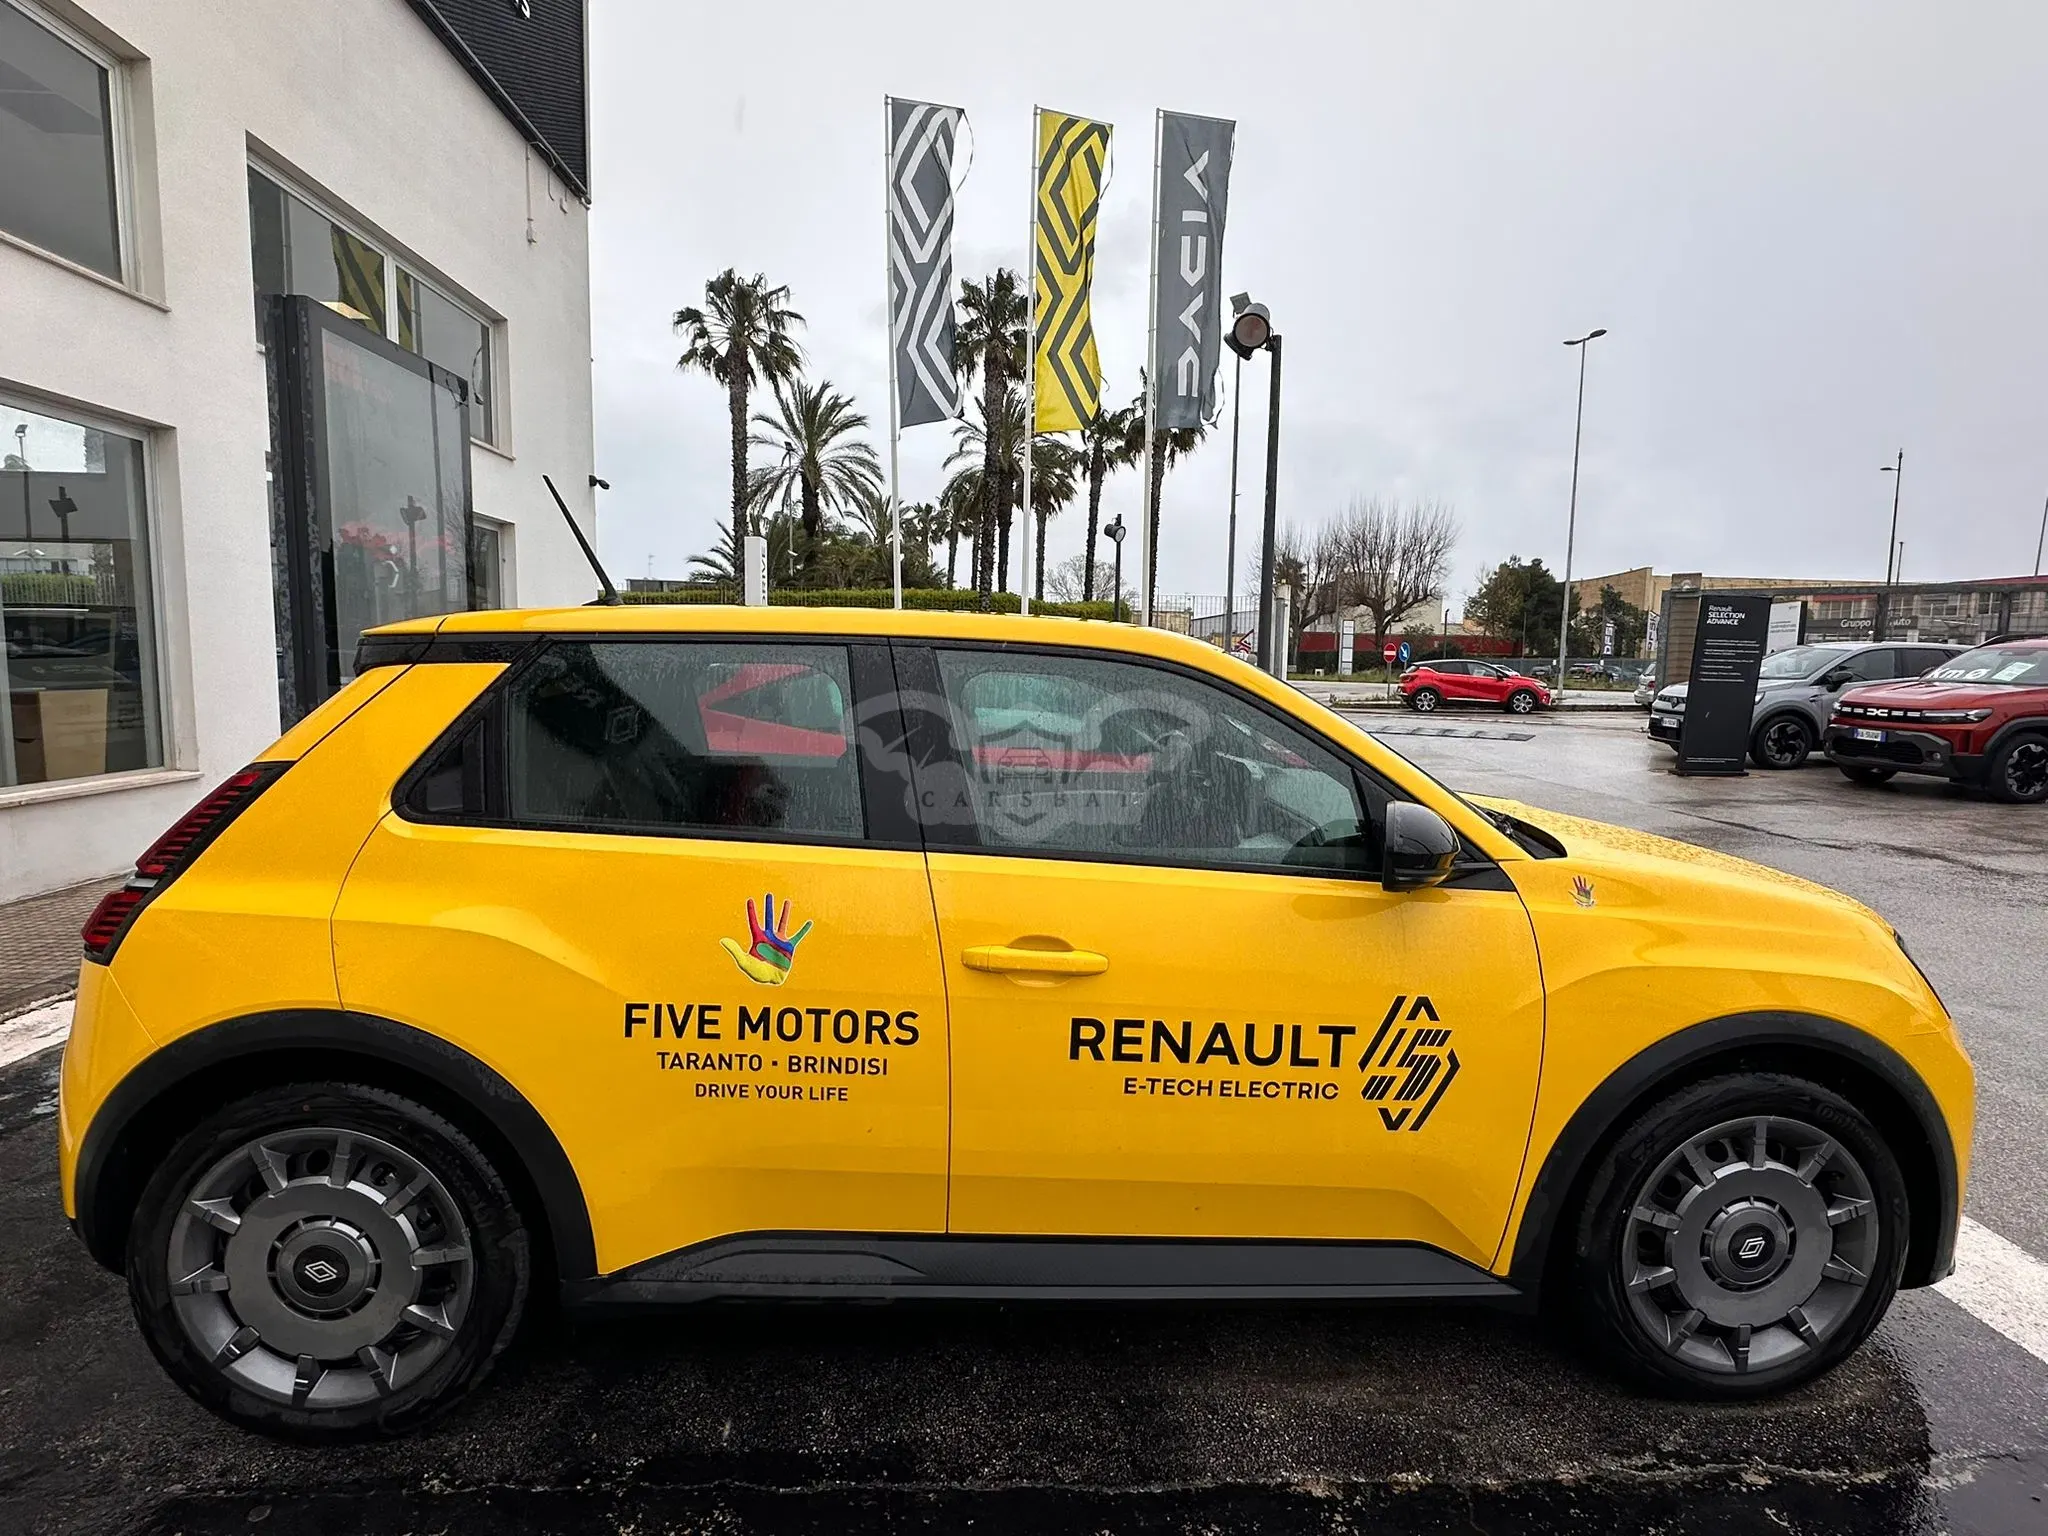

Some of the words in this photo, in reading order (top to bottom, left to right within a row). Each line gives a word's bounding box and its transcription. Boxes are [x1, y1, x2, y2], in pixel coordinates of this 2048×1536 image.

[1178, 150, 1209, 397] DACIA
[1708, 604, 1733, 612] Renault
[1708, 611, 1746, 619] SELECTION
[1706, 618, 1739, 626] ADVANCE
[1840, 619, 1872, 629] Gruppo
[624, 1003, 722, 1040] FIVE
[737, 1006, 920, 1046] MOTORS
[1069, 1017, 1357, 1068] RENAULT
[656, 1051, 763, 1072] TARANTO
[788, 1055, 888, 1076] BRINDISI
[695, 1083, 750, 1099] DRIVE
[754, 1085, 803, 1100] YOUR
[809, 1086, 849, 1102] LIFE
[1123, 1077, 1213, 1097] E-TECH
[1219, 1080, 1339, 1100] ELECTRIC
